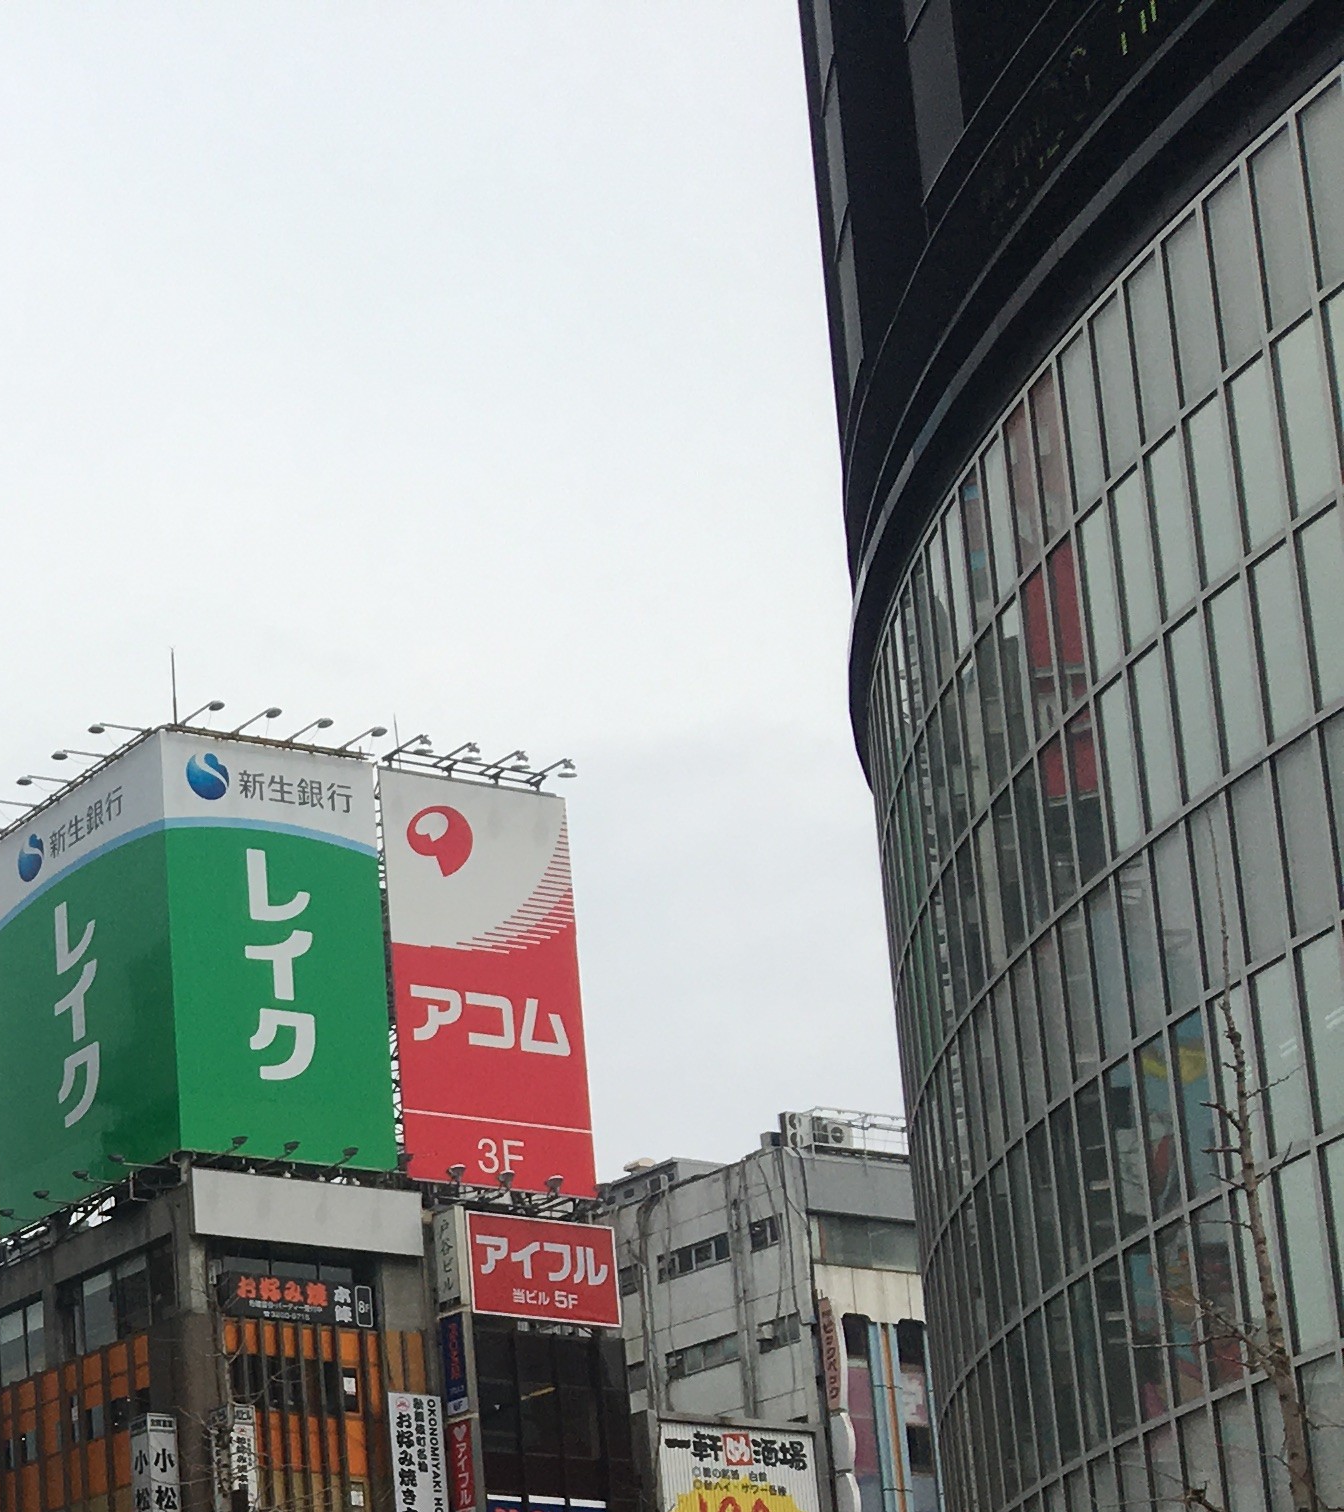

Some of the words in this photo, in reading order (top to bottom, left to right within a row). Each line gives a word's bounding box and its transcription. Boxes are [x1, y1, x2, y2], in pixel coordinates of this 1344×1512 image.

[48, 786, 124, 860] 新生銀行
[238, 769, 353, 815] 新生銀行
[244, 848, 317, 1082] レイク
[54, 901, 100, 1129] レイク
[410, 983, 571, 1058] アコム
[477, 1137, 525, 1176] 3F
[439, 1218, 455, 1292] 戸谷ビル
[475, 1234, 609, 1286] アイフル
[512, 1287, 550, 1306] 当ビル
[554, 1289, 578, 1310] 5F
[426, 1399, 443, 1493] OKONOMIYAKI
[455, 1441, 472, 1506] アイフル
[664, 1431, 808, 1471] 一軒め酒場
